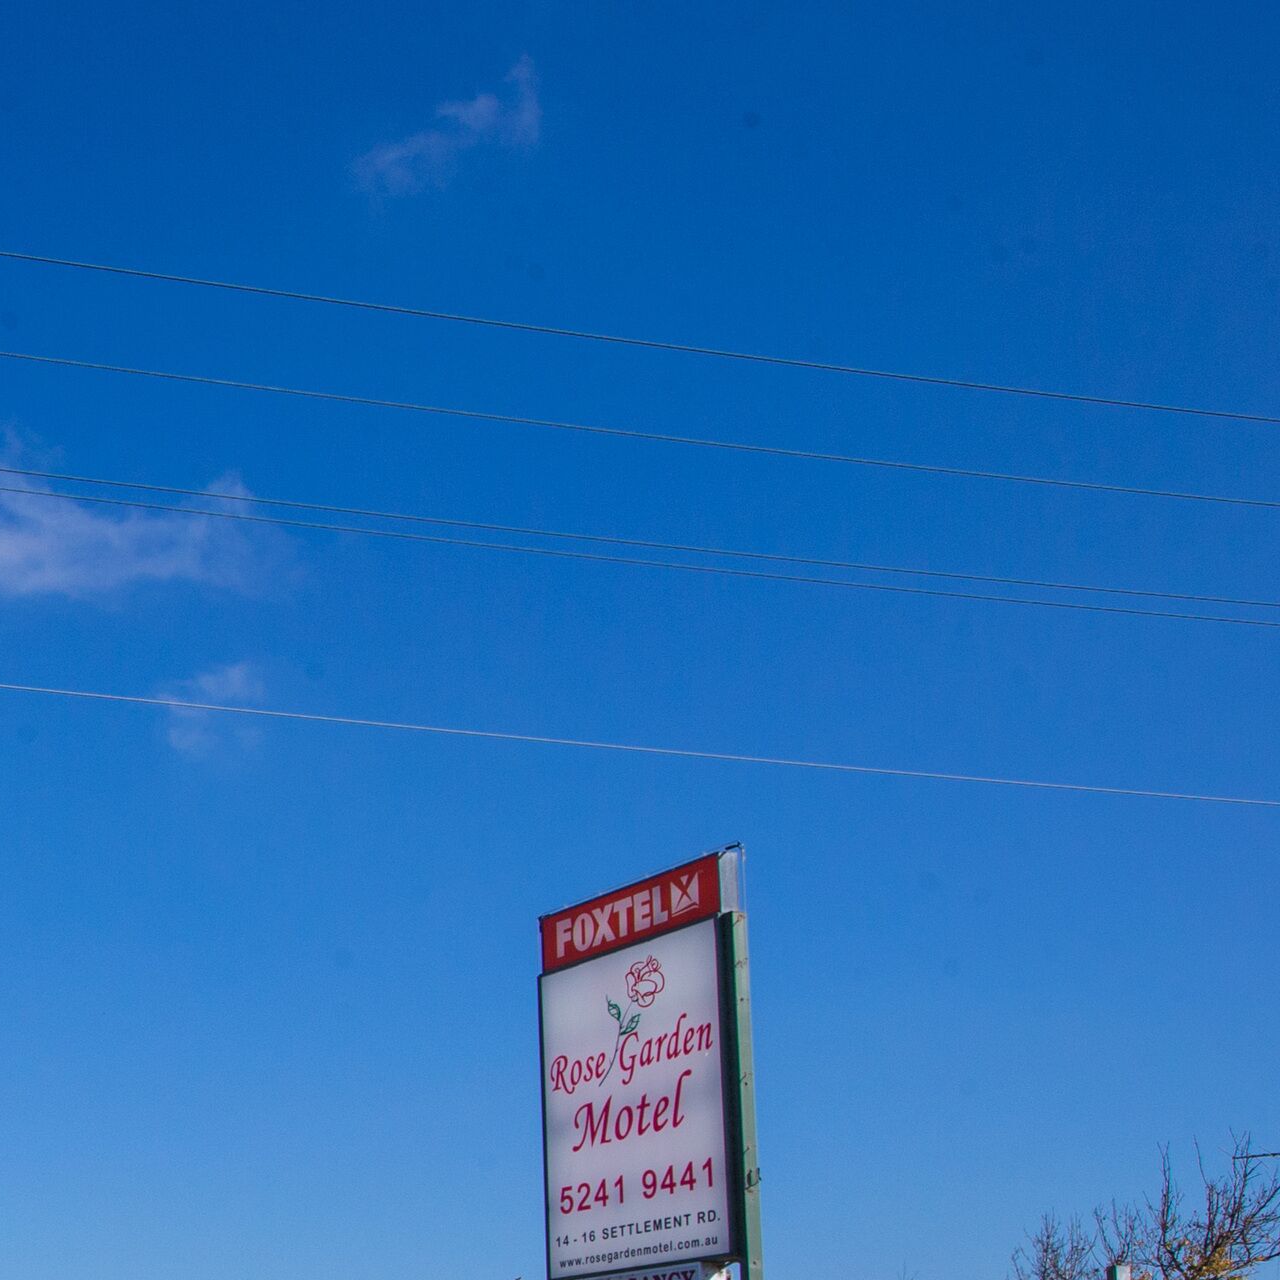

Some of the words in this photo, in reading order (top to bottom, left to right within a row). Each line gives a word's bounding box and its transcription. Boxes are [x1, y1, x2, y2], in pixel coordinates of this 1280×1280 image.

[555, 885, 669, 959] FOXTEL
[550, 1052, 606, 1095] Rose
[619, 1013, 713, 1085] Garden
[572, 1069, 692, 1152] Motel
[560, 1174, 624, 1214] 5241
[642, 1157, 713, 1199] 9441
[559, 1236, 719, 1268] www.rosegardenmotel.com.au
[602, 1213, 691, 1240] SETTLEMENT
[697, 1209, 721, 1225] RD.
